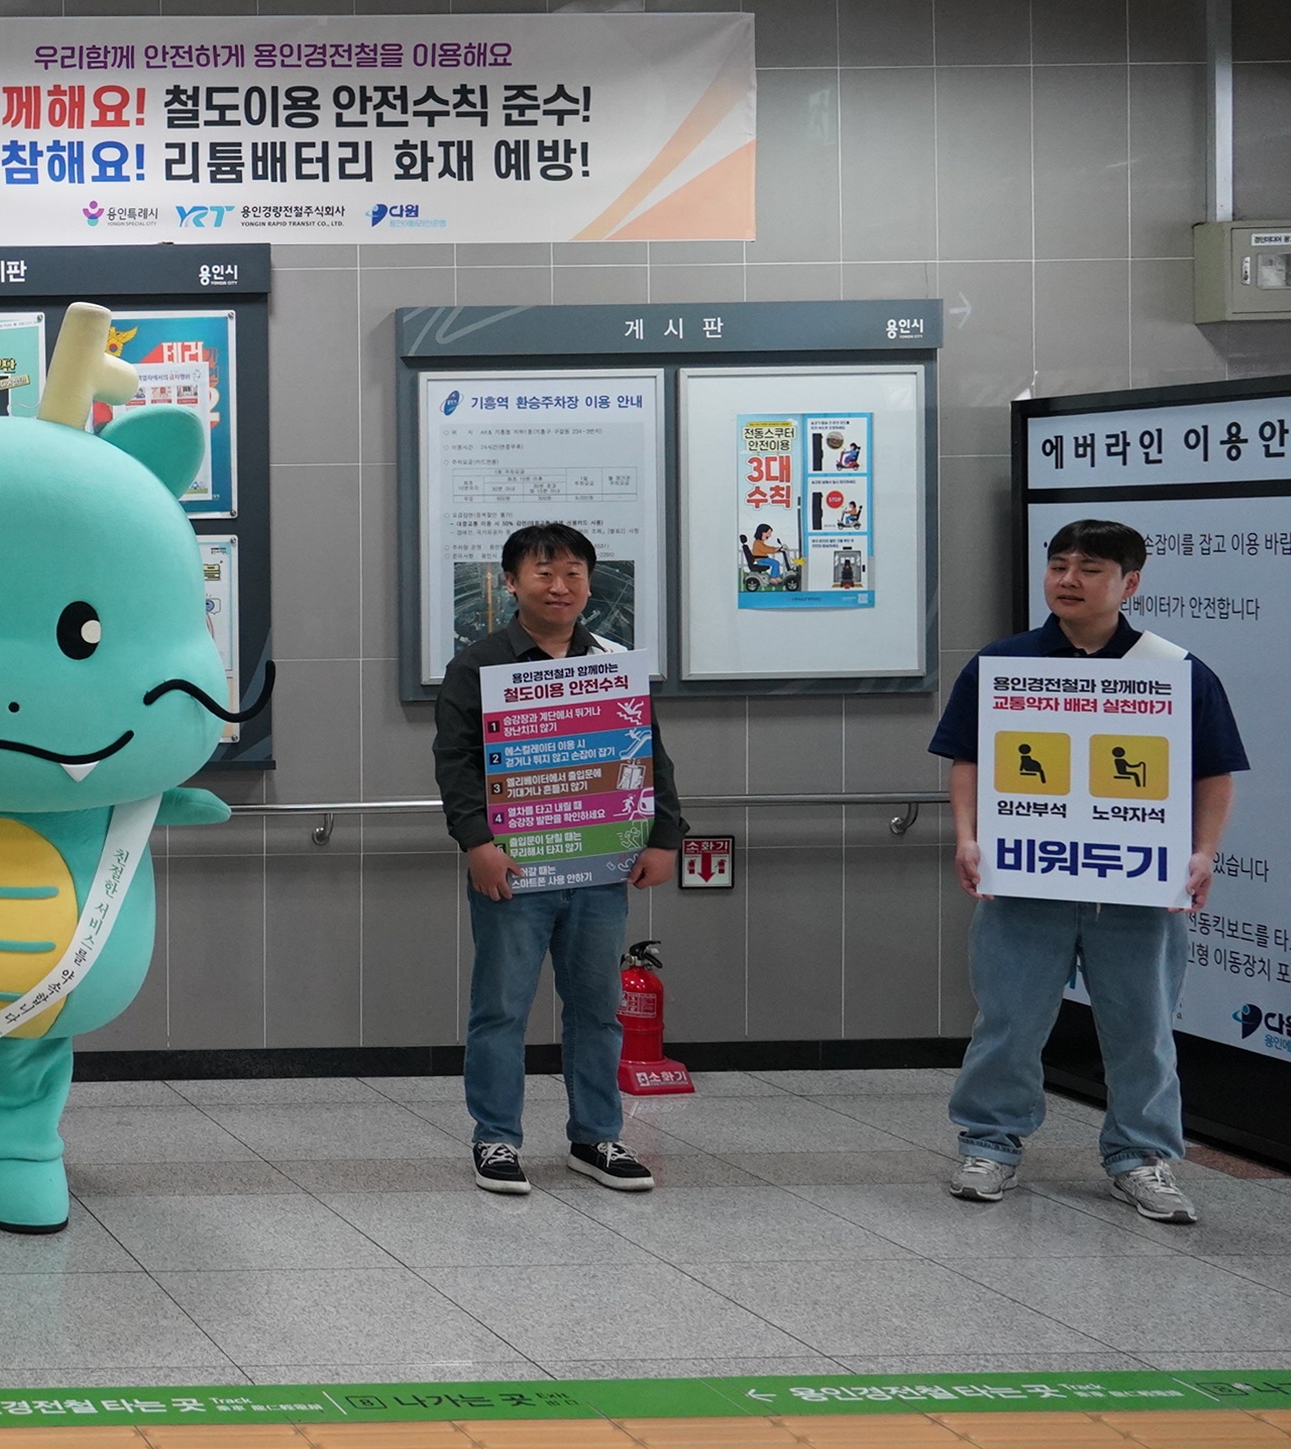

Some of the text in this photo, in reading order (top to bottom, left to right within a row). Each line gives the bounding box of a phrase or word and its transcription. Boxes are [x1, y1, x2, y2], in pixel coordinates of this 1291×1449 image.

[34, 42, 513, 70] 우리함께 안전하게 용인경전철을 이용해요
[164, 84, 320, 129] 철도이용
[332, 83, 488, 128] 안전수칙
[502, 84, 591, 127] 준수!
[164, 140, 373, 184] 리튬배터리
[394, 139, 473, 182] 화재
[494, 139, 590, 181] 예방!
[107, 206, 158, 221] 용인특례시
[175, 205, 235, 228] YRT
[240, 205, 345, 218] 용인경량전철주식회사
[389, 205, 419, 218] 다원
[199, 264, 238, 285] 용인시
[886, 318, 925, 339] 용인시
[471, 395, 643, 409] 기흥역 환승주차장 이용 안내
[744, 427, 795, 439] 전동스쿠터
[748, 440, 790, 451] 안전이용
[1041, 422, 1248, 469] 에버라인 이용
[747, 455, 791, 483] 3대
[746, 486, 791, 508] 수칙
[1198, 532, 1260, 556] 잡고 이용
[1120, 596, 1260, 620] 리베이터가 안전합니다
[512, 663, 618, 684] 용인경전철과 함께하는
[504, 675, 629, 702] 철도이용 안전수칙
[993, 676, 1172, 696] 용인경전철과 함께하는
[992, 695, 1173, 715] 교통약자 배려 실천하기
[503, 714, 537, 726] 승강장과
[997, 799, 1166, 824] 임산부석 노약자석
[686, 840, 729, 851] 소화기
[996, 838, 1168, 882] 비워두기
[5, 848, 130, 1025] 친절한 서비스를 약속합니다
[1214, 948, 1271, 982] 이동장치
[648, 1071, 687, 1082] 소화기
[102, 1398, 168, 1414] 타는
[172, 1397, 207, 1413] 곳
